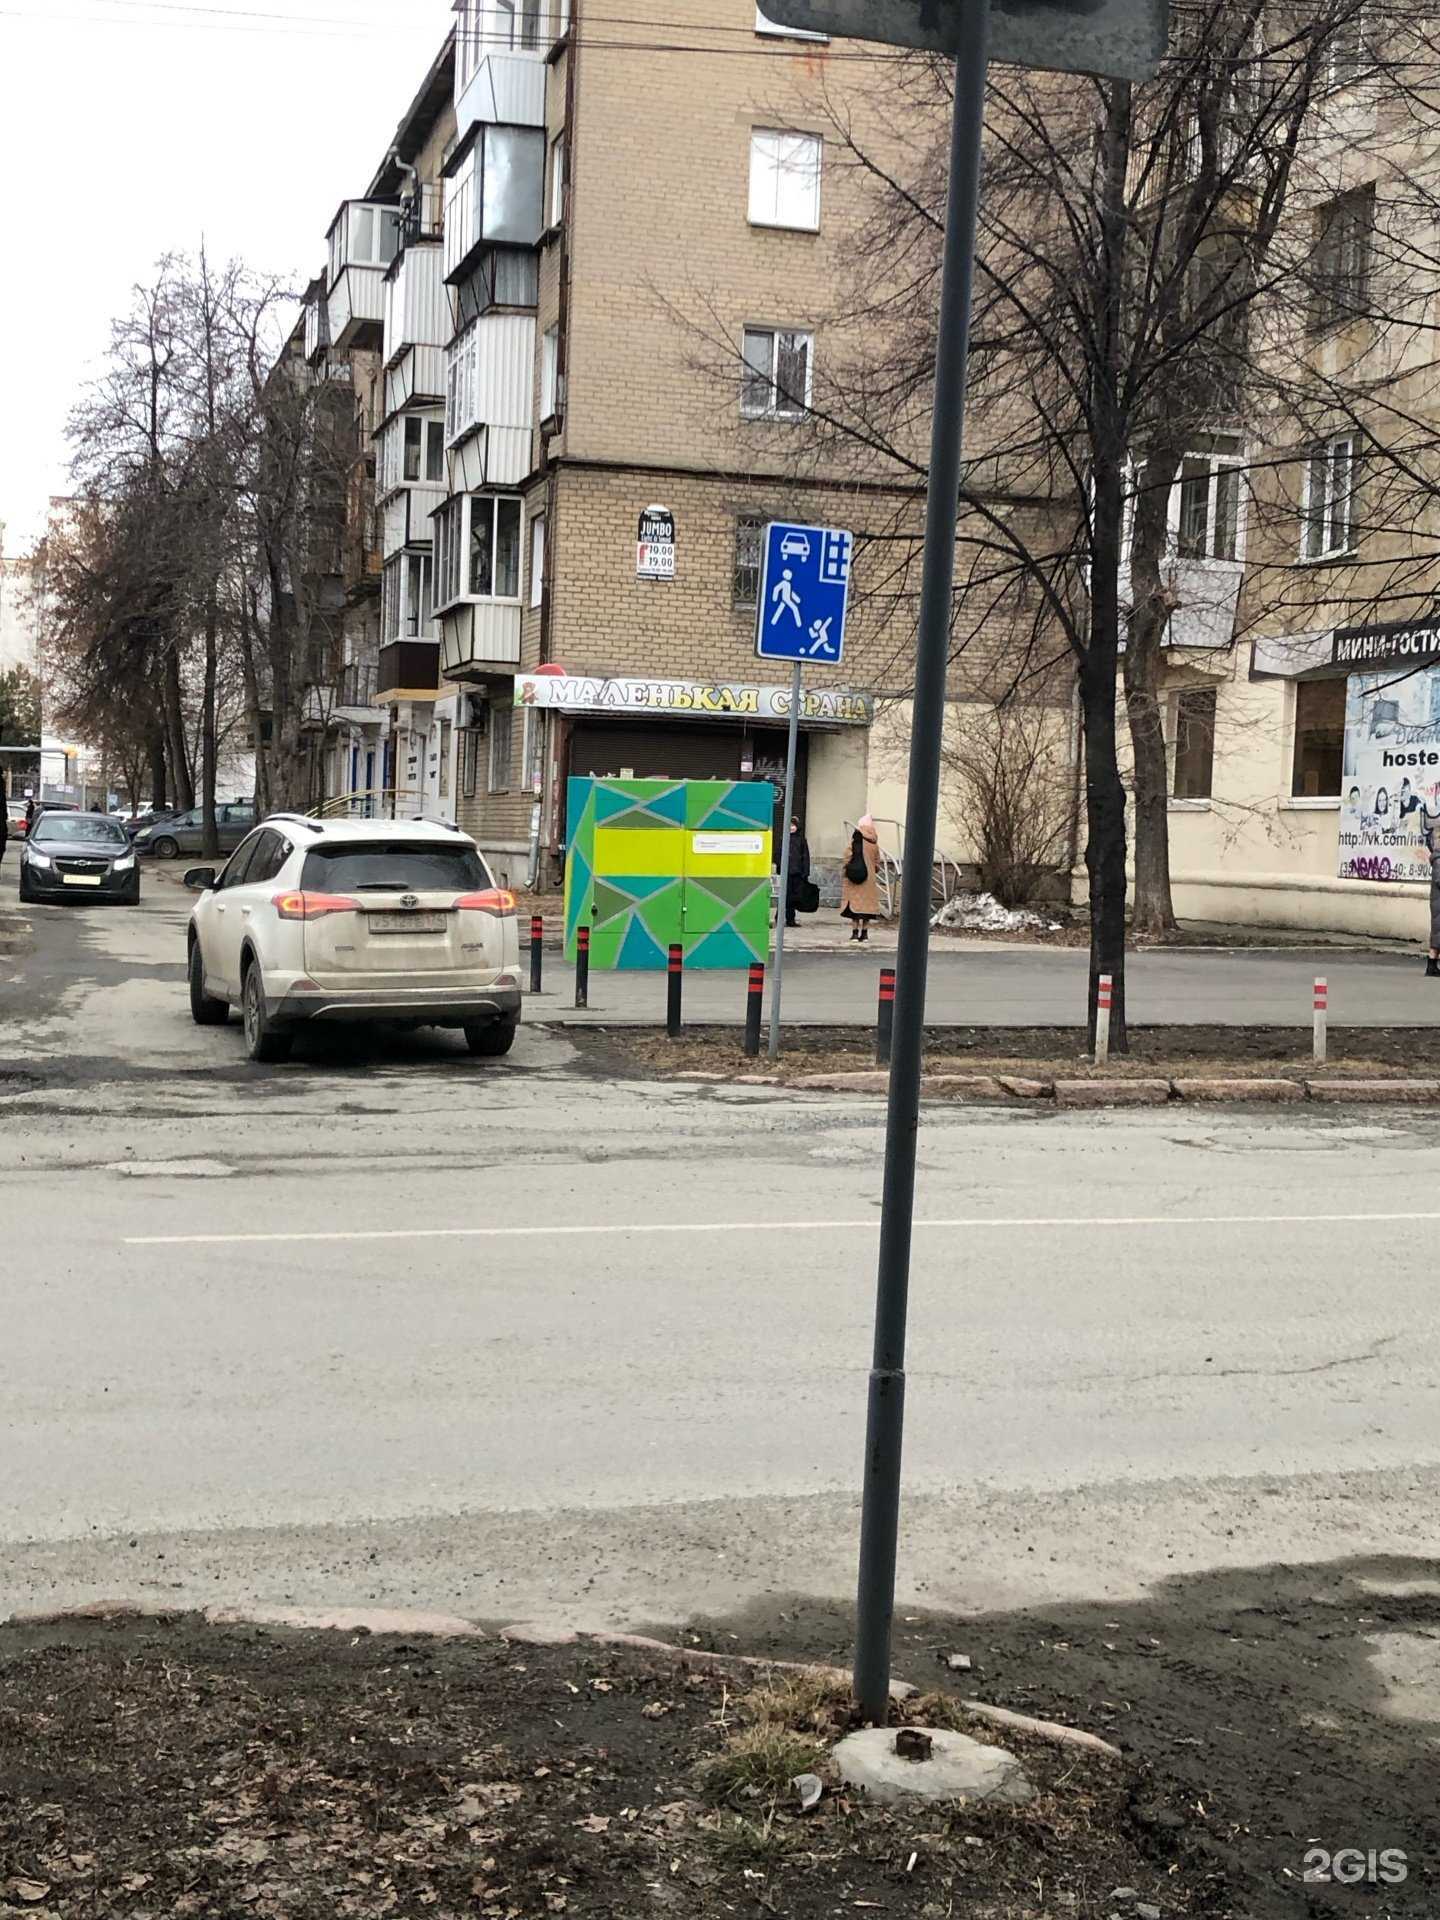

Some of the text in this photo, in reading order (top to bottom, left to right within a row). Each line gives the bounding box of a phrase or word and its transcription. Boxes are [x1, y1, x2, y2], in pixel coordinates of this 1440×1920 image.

[640, 521, 672, 537] JUMBO
[649, 556, 673, 568] 19.00
[549, 679, 760, 713] МАЛЕНЬКАЯ
